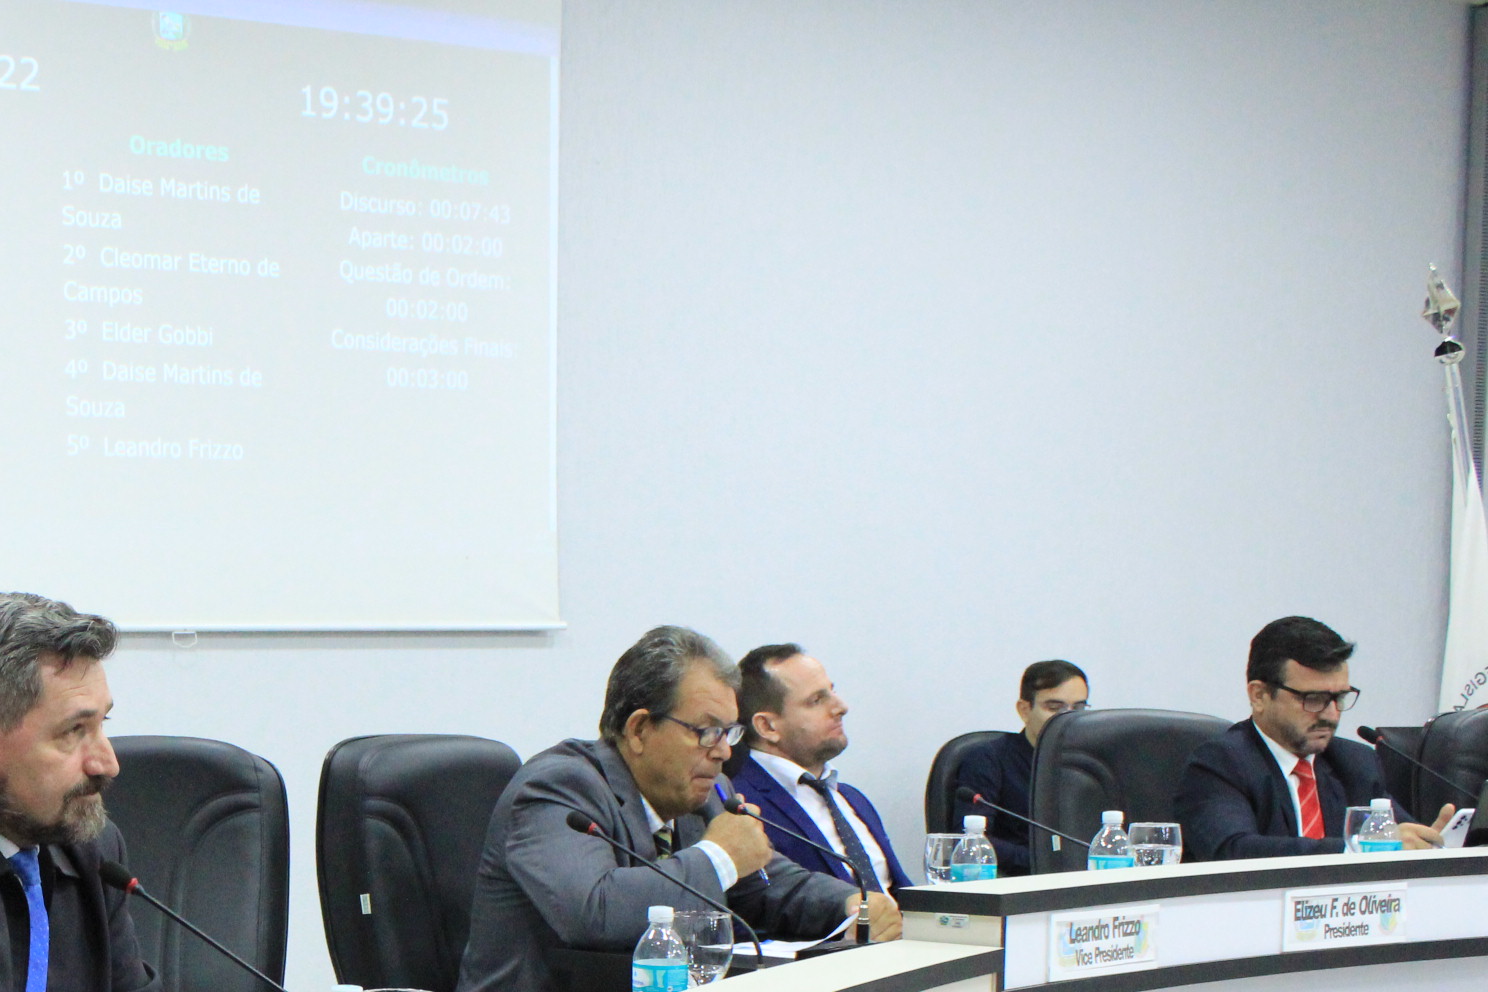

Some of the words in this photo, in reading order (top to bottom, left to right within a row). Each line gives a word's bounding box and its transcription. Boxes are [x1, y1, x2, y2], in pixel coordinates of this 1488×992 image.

[302, 85, 449, 130] 19:39:25
[129, 135, 230, 162] Oradores
[362, 156, 490, 185] Cronômetros
[98, 173, 153, 196] Daise
[160, 177, 231, 202] Martins
[237, 184, 261, 204] de
[62, 206, 122, 229] Souza
[340, 191, 423, 216] Discurso:
[429, 199, 510, 224] 00:07:43
[348, 227, 415, 250] Aparte:
[421, 233, 503, 257] 00:02:00
[100, 247, 182, 271] Cleomar
[188, 252, 251, 276] Eterno
[257, 257, 280, 278] de
[339, 260, 413, 284] Questão
[419, 267, 441, 287] de
[446, 268, 512, 291] Ordem:
[64, 280, 144, 307] Campos
[385, 298, 469, 322] 00:02:00
[102, 321, 152, 343] Elder
[158, 324, 214, 346] Gobbi
[331, 328, 458, 358] Considerações
[102, 361, 157, 383] Daise
[163, 363, 233, 386] Martins
[239, 367, 263, 388] de
[386, 367, 469, 390] 00:03:00
[66, 396, 126, 418] Souza
[104, 436, 182, 459] Leandro
[188, 439, 244, 460] Frizzo
[1293, 899, 1327, 921] Elizeu
[1330, 897, 1339, 918] F.
[1341, 896, 1356, 917] de
[1358, 893, 1401, 915] Oliveira
[1069, 918, 1110, 944] Leandro
[1112, 916, 1141, 939] Frizzo
[1323, 921, 1369, 939] Presidente
[1075, 948, 1093, 966] Vice
[1094, 944, 1134, 963] Presidente
